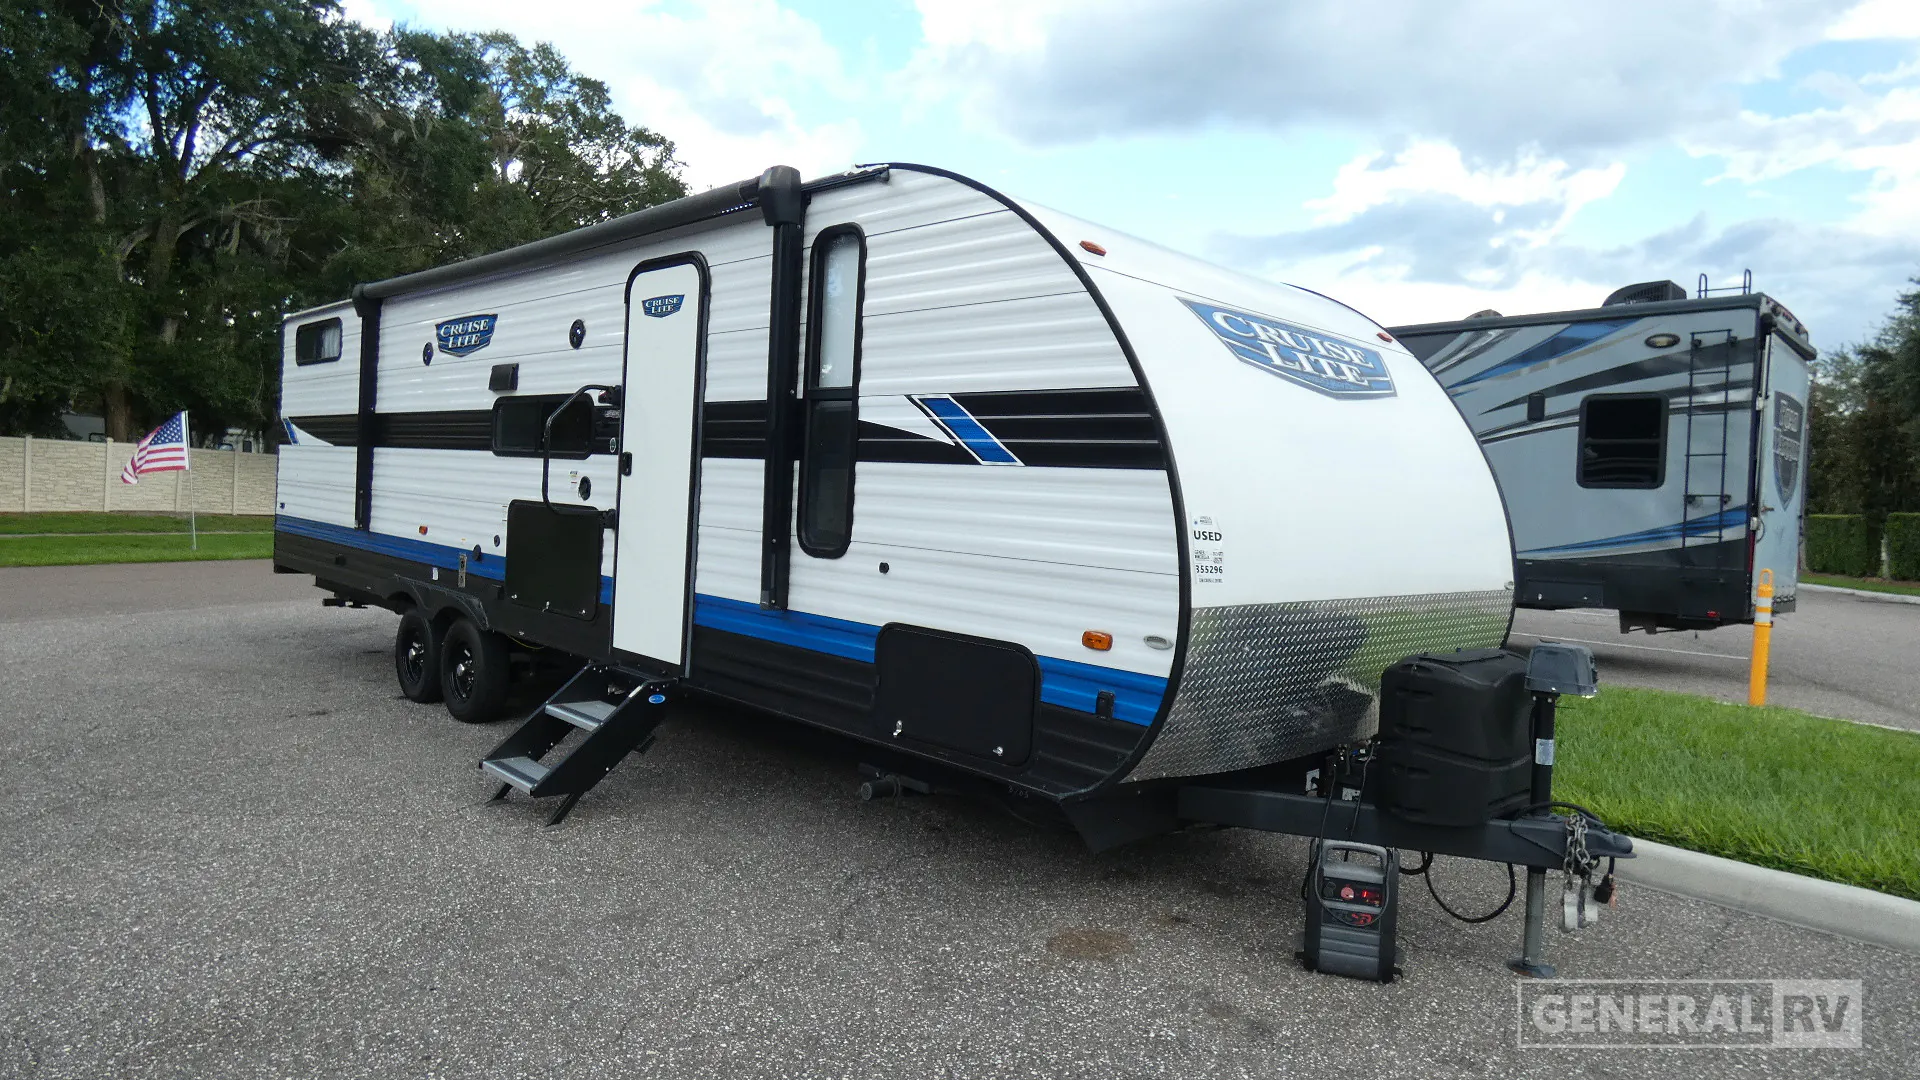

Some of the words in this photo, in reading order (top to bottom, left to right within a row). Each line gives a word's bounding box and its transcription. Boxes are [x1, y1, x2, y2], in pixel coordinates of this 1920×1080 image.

[645, 297, 680, 308] CRUISE
[651, 304, 674, 314] LITE
[440, 319, 489, 338] CRUISE
[448, 333, 480, 348] LITE
[1212, 311, 1374, 369] CRUISE
[1257, 340, 1369, 387] LITE
[1193, 530, 1222, 542] USED
[1195, 564, 1223, 574] 355296
